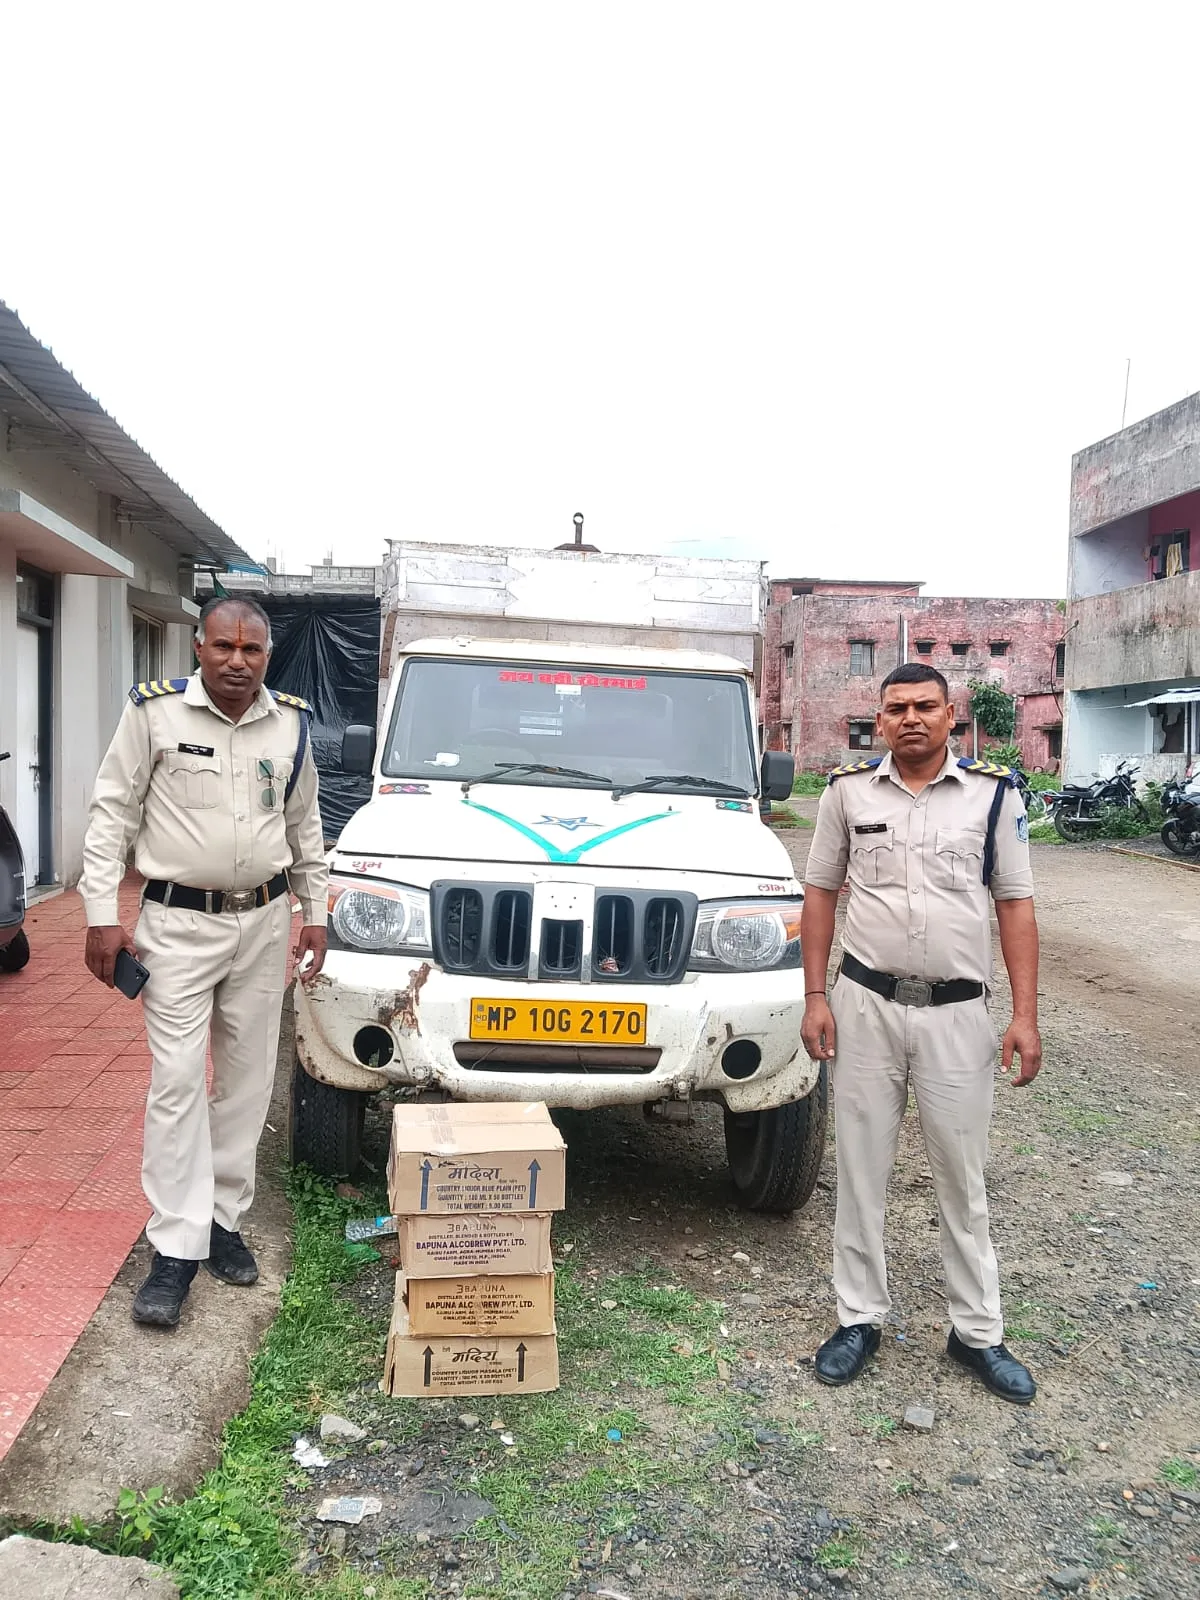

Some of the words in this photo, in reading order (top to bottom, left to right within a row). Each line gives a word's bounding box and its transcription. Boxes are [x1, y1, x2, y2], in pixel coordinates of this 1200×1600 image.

[487, 1006, 516, 1031] MP
[529, 1007, 571, 1032] 10G
[580, 1009, 641, 1035] 2170
[416, 1241, 448, 1250] BAPUNA
[449, 1239, 492, 1249] ALCOBREW
[493, 1239, 510, 1247] PVT.
[511, 1238, 527, 1247] LTD.
[425, 1301, 457, 1309] BAPUNA
[501, 1300, 518, 1308] PVT.
[519, 1300, 535, 1308] LTD.
[452, 1347, 498, 1363] मदिरा
